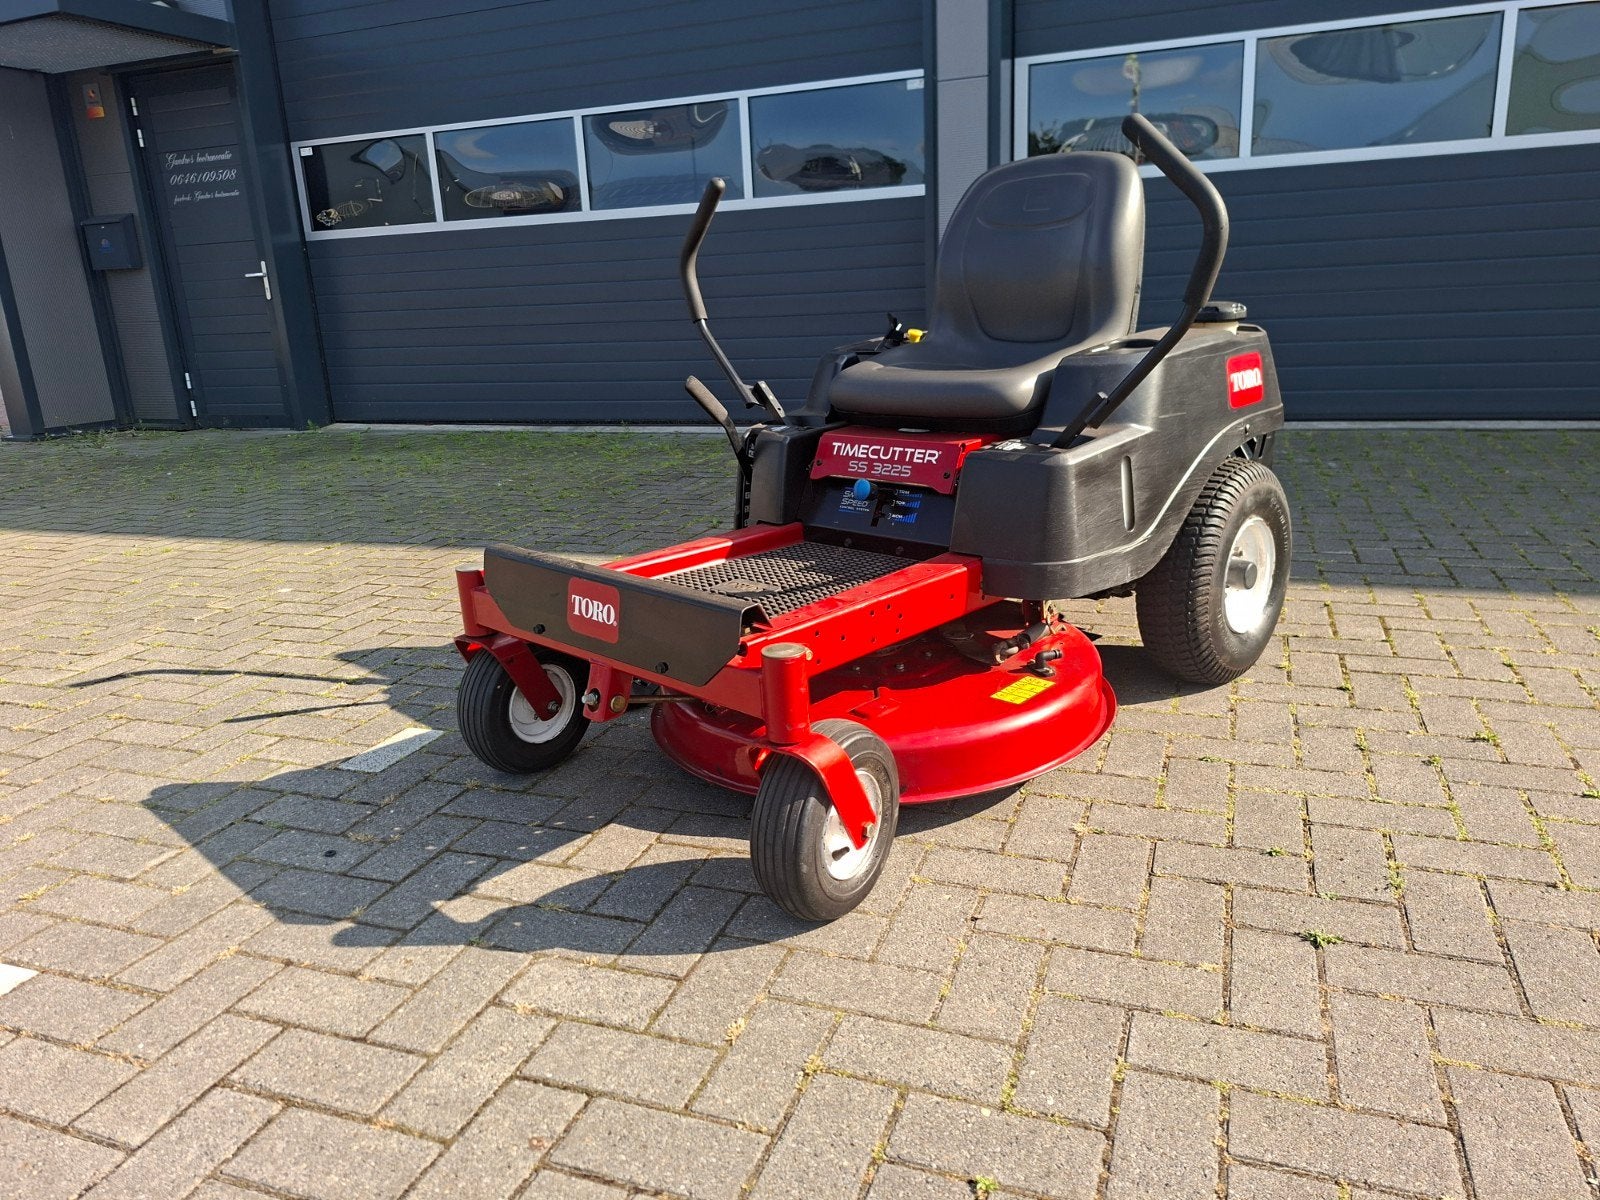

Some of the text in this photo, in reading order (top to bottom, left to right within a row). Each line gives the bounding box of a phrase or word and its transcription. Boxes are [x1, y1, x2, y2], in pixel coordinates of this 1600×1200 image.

[1230, 367, 1262, 392] TORO
[832, 442, 940, 464] TIMECUTTER
[848, 461, 912, 477] SS 3225
[841, 498, 868, 507] SPEED
[571, 594, 616, 625] TORO
